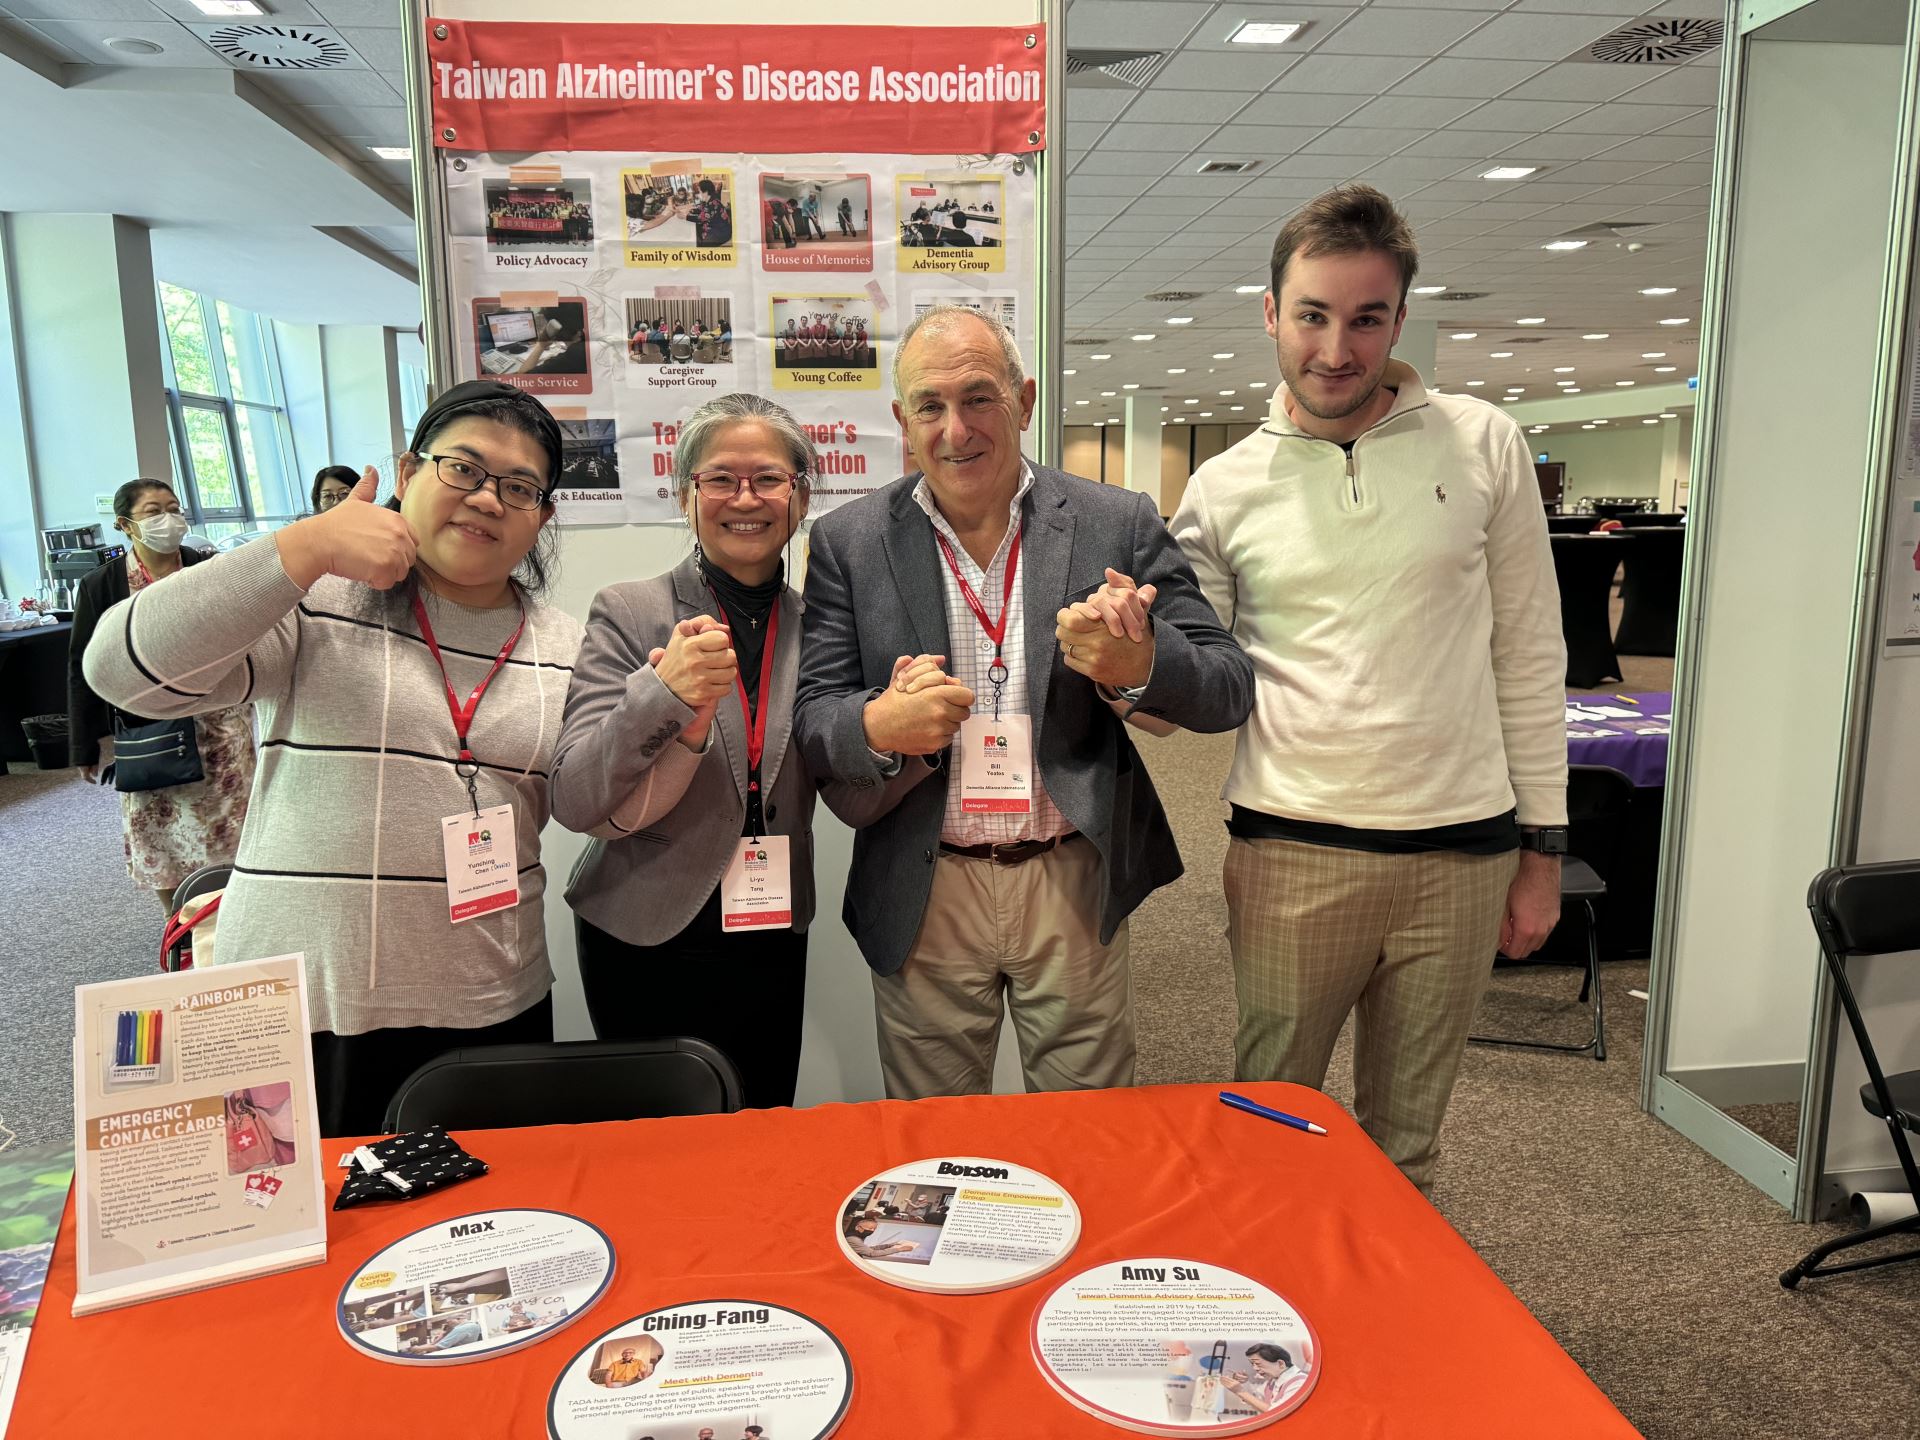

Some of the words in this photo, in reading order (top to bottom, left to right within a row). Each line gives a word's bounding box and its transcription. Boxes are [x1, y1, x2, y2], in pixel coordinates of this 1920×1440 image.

[437, 61, 547, 99] Taiwan
[556, 61, 733, 100] Alzheimer's
[742, 63, 859, 102] Disease
[869, 64, 1040, 102] Association
[631, 251, 669, 262] Family
[672, 251, 685, 261] of
[685, 251, 731, 261] Wisdom
[927, 248, 973, 258] Dementia
[496, 255, 531, 268] Policy
[534, 254, 588, 268] Advocacy
[765, 254, 799, 264] House
[803, 254, 815, 264] of
[817, 254, 870, 265] Memories
[912, 260, 956, 271] Advisory
[959, 260, 990, 271] Group
[660, 366, 704, 377] Caregiver
[538, 377, 578, 387] Service
[648, 377, 685, 387] Support
[688, 377, 717, 387] Group
[791, 372, 826, 384] Young
[828, 372, 862, 382] Coffee
[561, 492, 569, 500] &
[572, 492, 622, 500] Education
[468, 859, 495, 868] Yunching
[455, 905, 477, 914] Delegate
[180, 988, 243, 1009] RAINBOW
[248, 983, 275, 998] PEN
[100, 1104, 193, 1132] EMERGENCY
[100, 1124, 170, 1148] CONTACT
[175, 1115, 225, 1134] CARDS
[937, 1162, 1009, 1180] Borson
[1003, 1193, 1058, 1202] Empowerment
[450, 1220, 495, 1238] Max
[360, 1273, 389, 1281] Young
[1121, 1266, 1166, 1282] Amy
[1172, 1266, 1200, 1281] Su
[360, 1278, 391, 1287] Coffee
[642, 1308, 770, 1332] Ching-Fang
[717, 1371, 764, 1380] Dementia
[610, 1394, 647, 1402] arranged
[692, 1388, 716, 1396] public
[719, 1384, 755, 1392] speaking
[574, 1411, 610, 1419] personal
[612, 1407, 661, 1416] experiences
